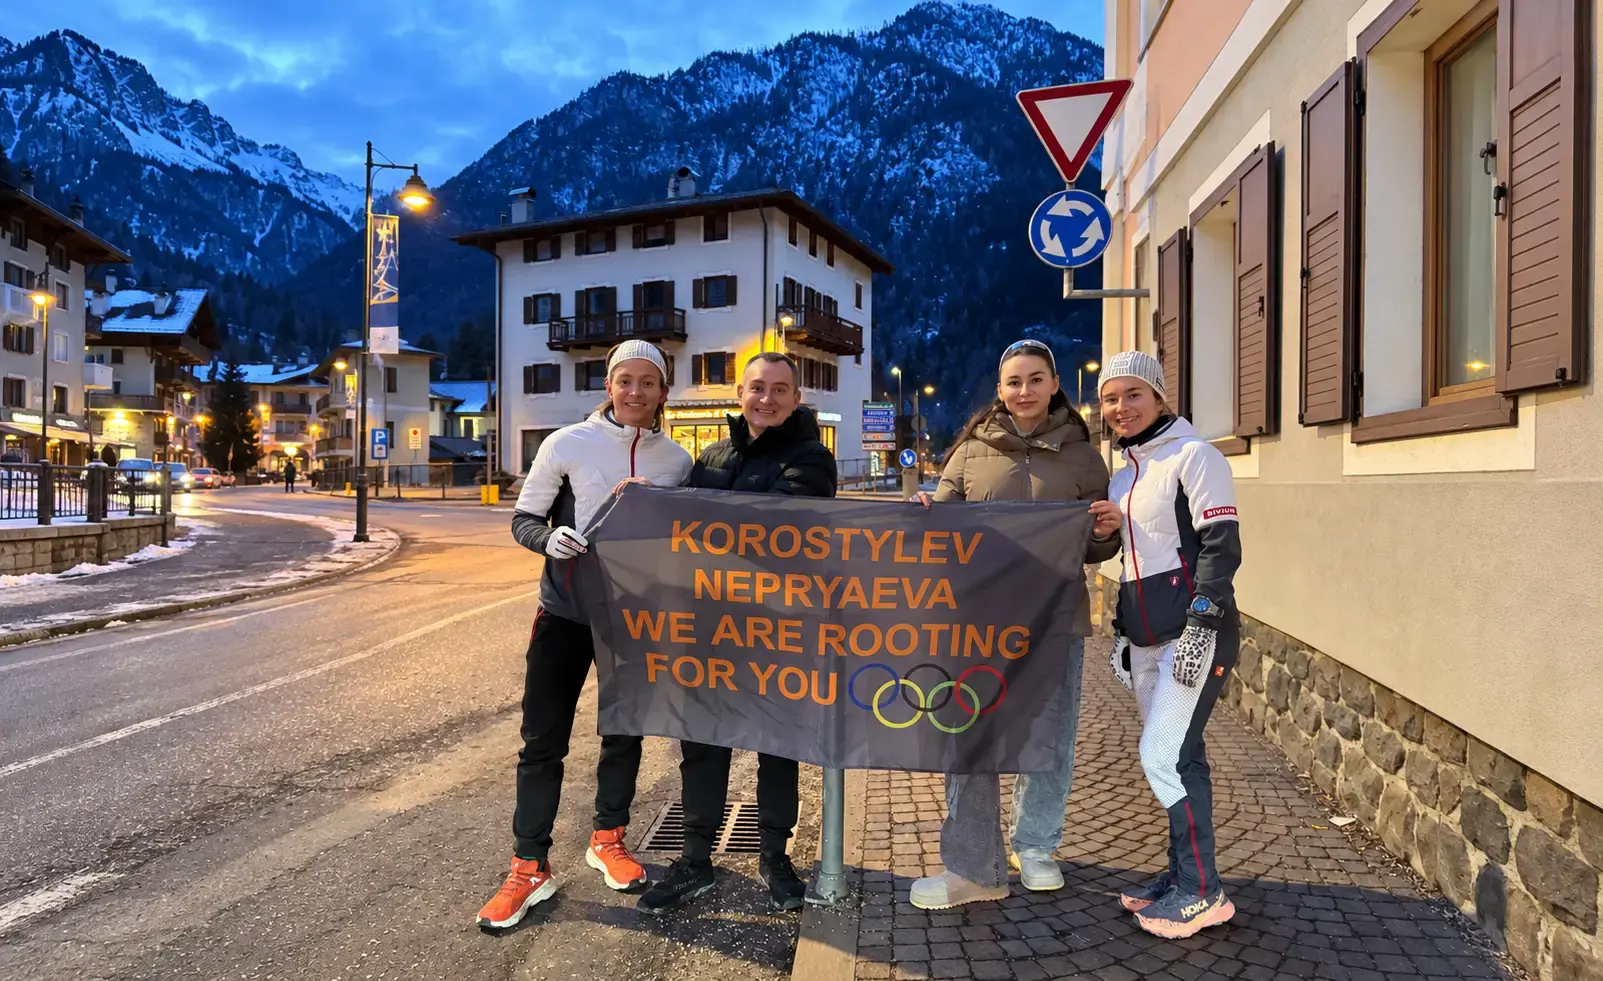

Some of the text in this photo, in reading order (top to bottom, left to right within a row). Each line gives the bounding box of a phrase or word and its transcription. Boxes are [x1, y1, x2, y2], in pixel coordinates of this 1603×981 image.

[670, 520, 984, 565] KOROSTYLEV
[693, 567, 958, 610] NEPRYAEVA
[622, 608, 1031, 660] WE ARE ROOTING
[645, 652, 838, 706] FOR YOU
[1180, 899, 1209, 919] HOKA
